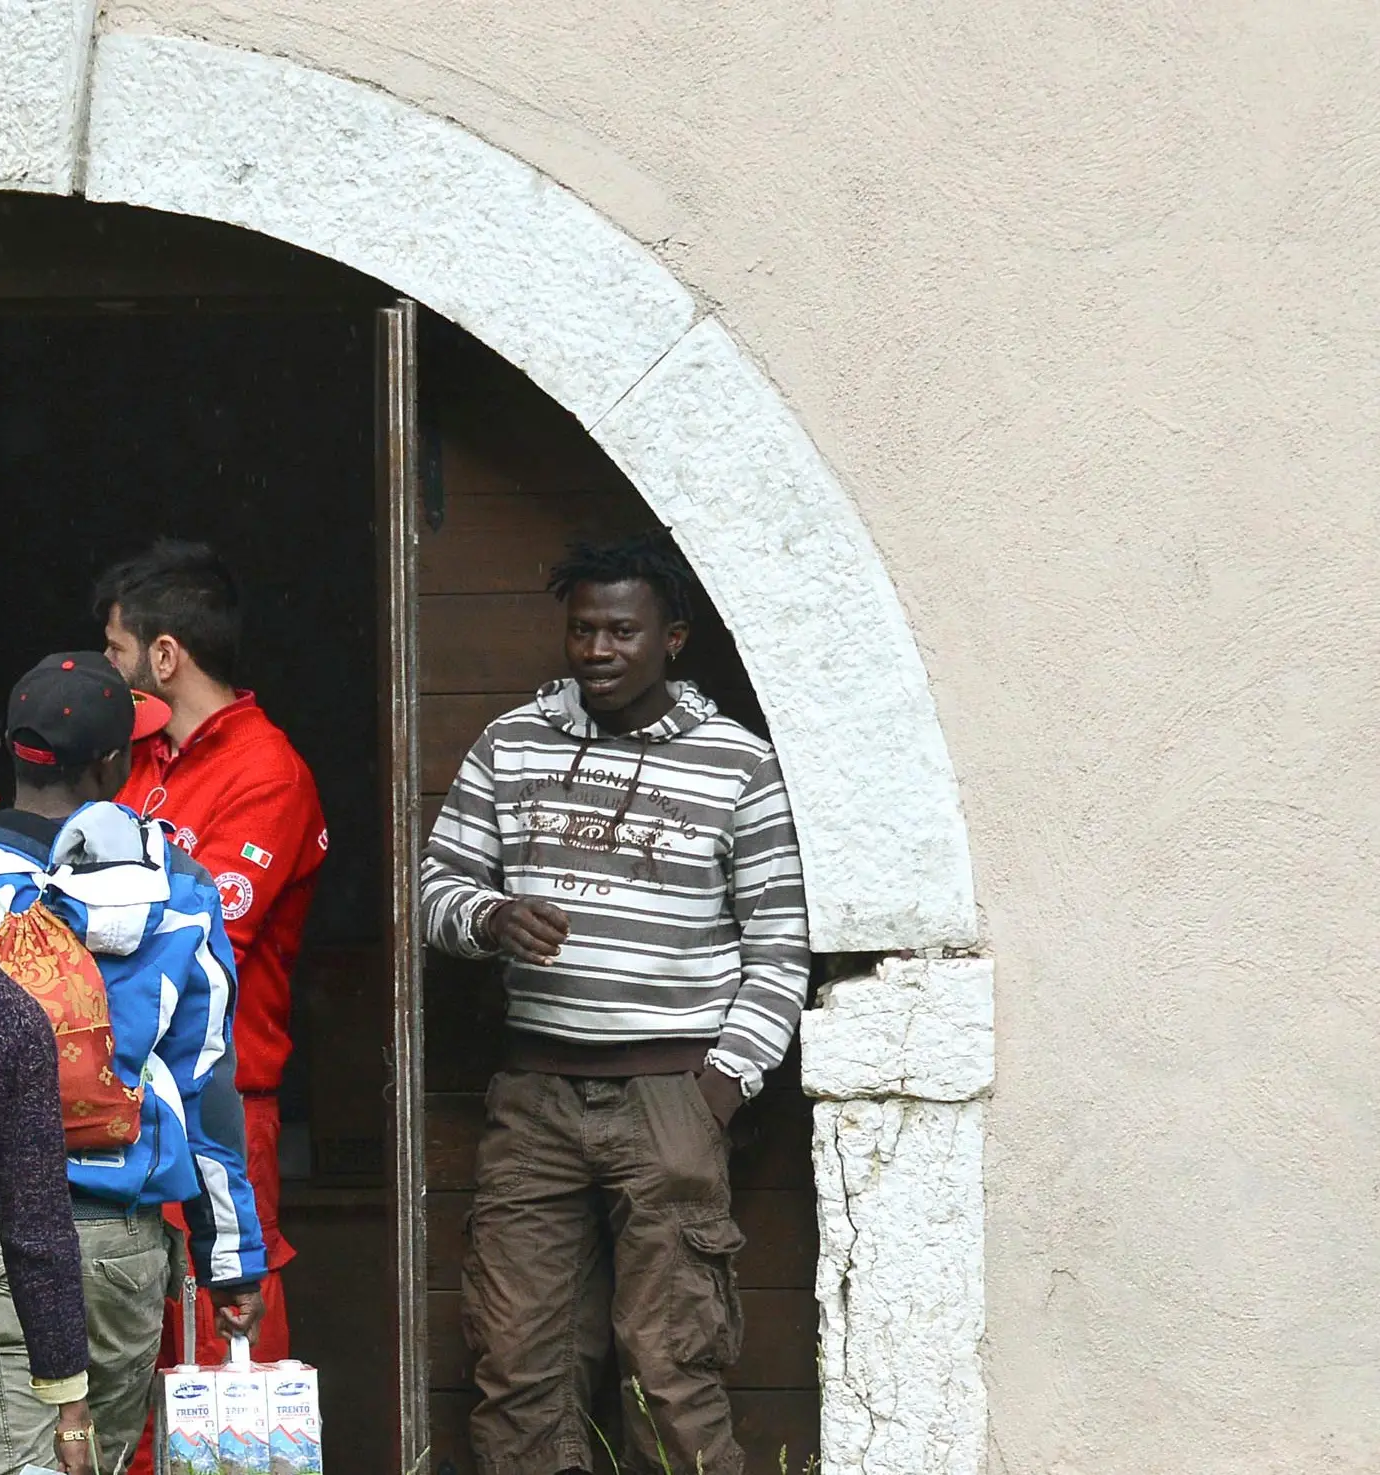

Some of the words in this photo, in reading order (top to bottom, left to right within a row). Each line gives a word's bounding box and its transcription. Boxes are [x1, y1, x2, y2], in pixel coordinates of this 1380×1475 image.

[647, 789, 697, 840] BRAND
[176, 1408, 209, 1416] TRENTO
[276, 1405, 310, 1414] TRENTO
